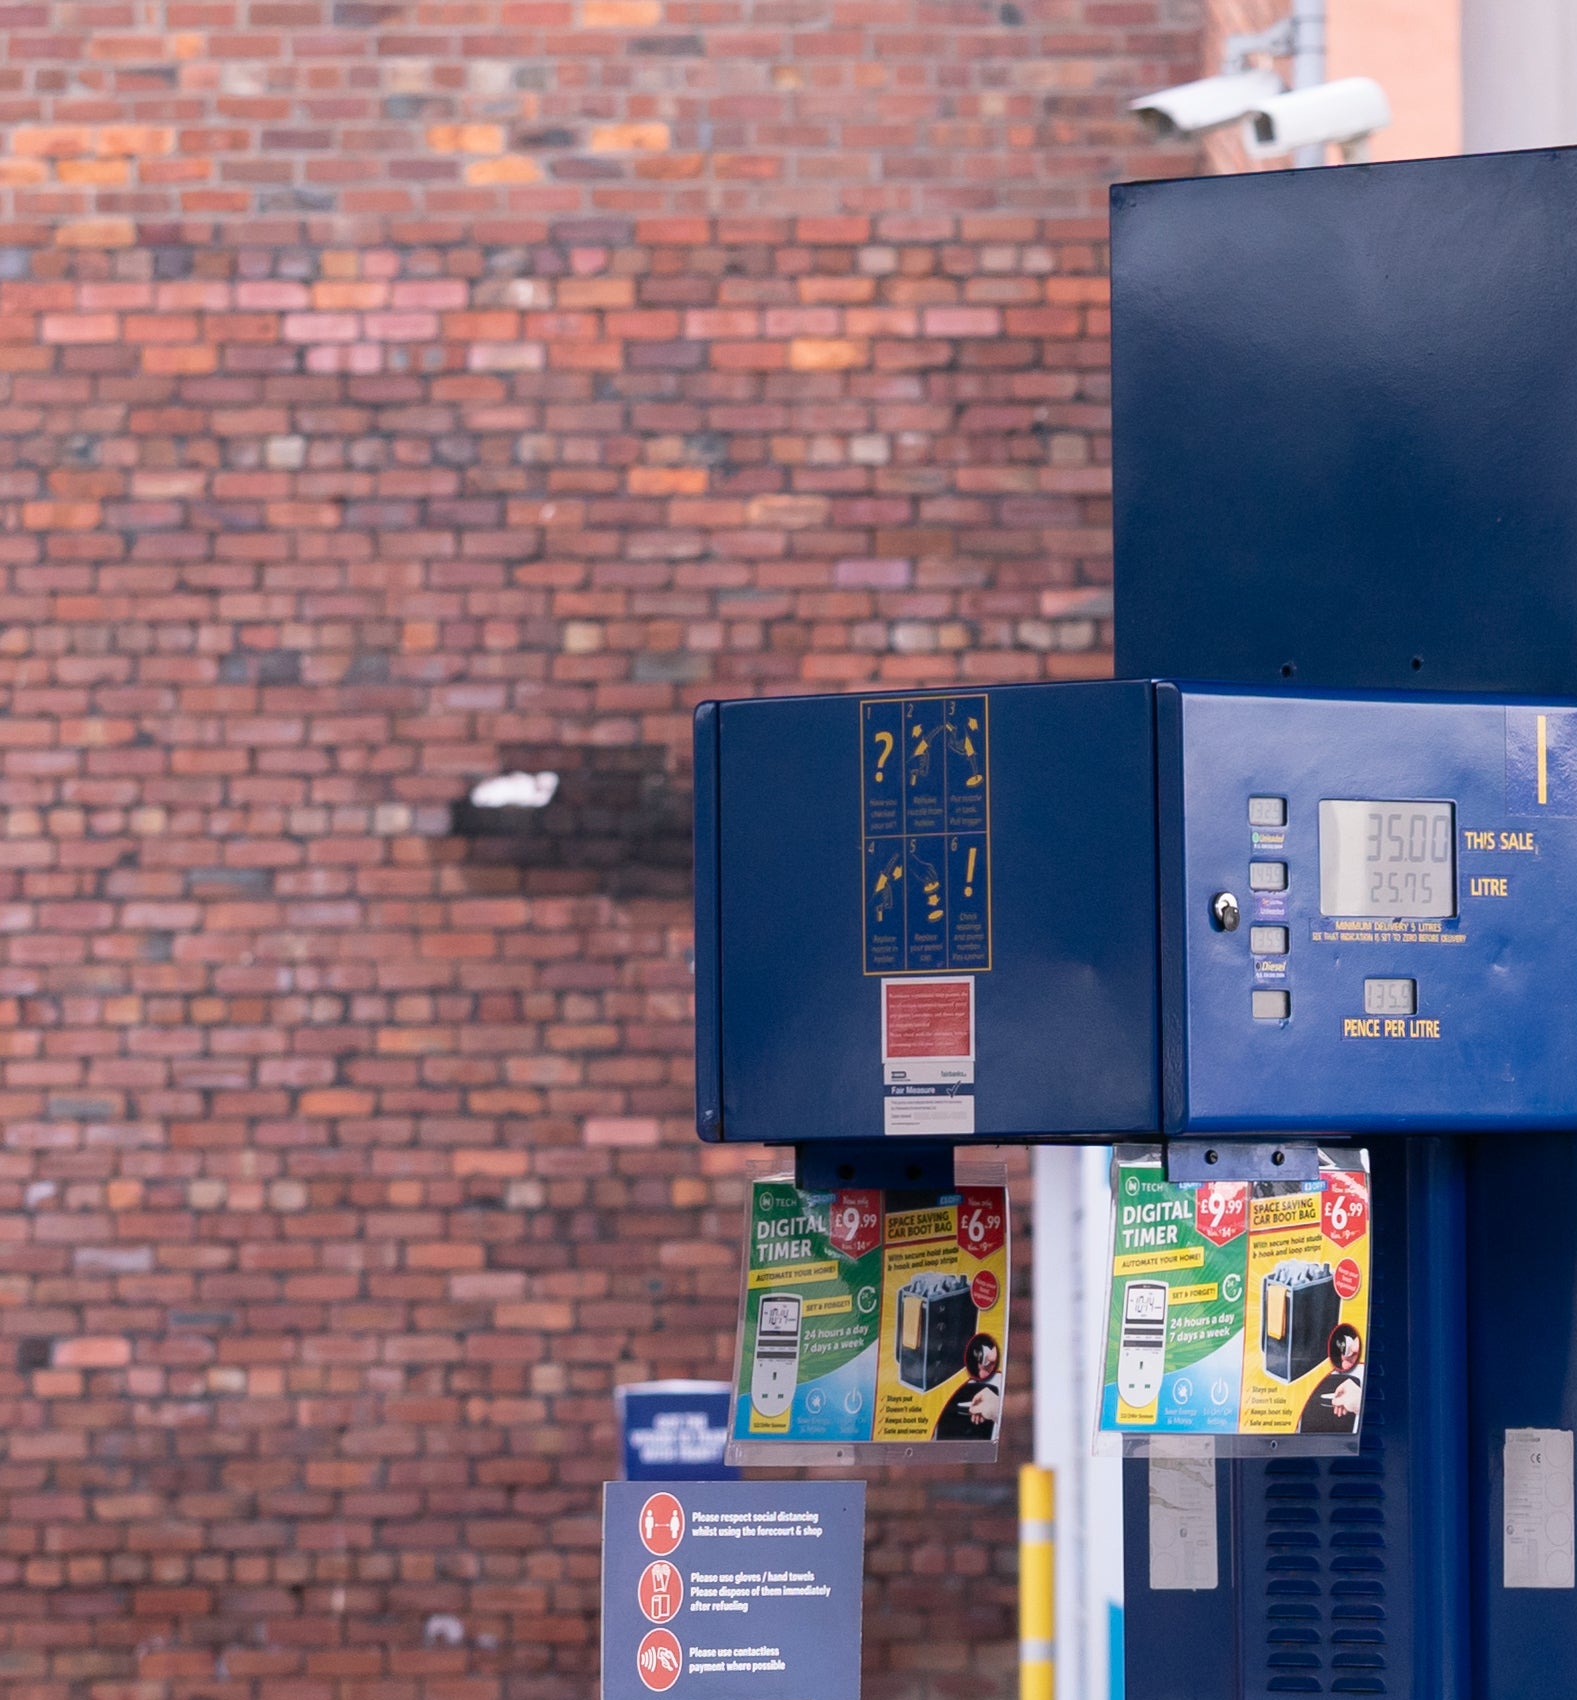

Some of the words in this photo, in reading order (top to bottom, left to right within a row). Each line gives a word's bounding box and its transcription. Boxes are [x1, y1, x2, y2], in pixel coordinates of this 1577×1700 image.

[948, 701, 955, 715] 3
[1367, 814, 1450, 863] 35.00
[1465, 831, 1495, 850] THIS
[1501, 832, 1534, 850] SALE
[1371, 872, 1432, 903] 25.75
[1471, 879, 1508, 896] LITRE
[1418, 922, 1442, 933] LITRES
[1262, 961, 1287, 971] Diesel
[1344, 1019, 1380, 1037] PENCE
[1384, 1019, 1405, 1037] PER
[1410, 1020, 1440, 1038] LITRE
[891, 1086, 904, 1094] Fair
[906, 1086, 935, 1094] Measure
[1141, 1183, 1163, 1192] TECH
[776, 1198, 797, 1207] TECH
[1200, 1193, 1242, 1227] £9.99
[1254, 1202, 1280, 1214] SPACE
[1282, 1198, 1313, 1210] SAVING
[889, 1216, 915, 1228] SPACE
[917, 1211, 949, 1223] SAVING
[1123, 1200, 1192, 1225] DIGITAL
[1254, 1214, 1270, 1225] CAR
[1273, 1212, 1297, 1223] BOOT
[1299, 1209, 1316, 1219] BAG
[1325, 1196, 1363, 1230] £6.99
[757, 1216, 826, 1239] DIGITAL
[835, 1207, 877, 1241] £9.99
[888, 1227, 905, 1239] CAR
[908, 1225, 932, 1236] BOOT
[935, 1221, 952, 1233] BAG
[961, 1208, 1000, 1242] £6.99
[1123, 1225, 1178, 1248] TIMER
[757, 1240, 812, 1262] TIMER
[1122, 1258, 1158, 1268] AUTOMATE
[1160, 1255, 1177, 1264] YOUR
[1179, 1253, 1200, 1262] HOME!
[756, 1270, 792, 1281] AUTOMATE
[794, 1268, 812, 1277] YOUR
[1170, 1318, 1182, 1329] 24
[1184, 1315, 1210, 1328] hours
[1218, 1313, 1234, 1325] day
[804, 1330, 816, 1340] 24
[818, 1327, 844, 1339] hours
[853, 1324, 869, 1336] day
[1170, 1333, 1175, 1343] 7
[1177, 1331, 1197, 1342] days
[1206, 1327, 1230, 1338] week
[804, 1343, 809, 1353] 7
[811, 1341, 831, 1355] days
[841, 1338, 864, 1349] week
[692, 1511, 719, 1523] Please
[721, 1512, 752, 1525] respect
[753, 1512, 776, 1522] social
[778, 1511, 819, 1524] distancing
[692, 1526, 717, 1537] whilst
[719, 1527, 741, 1539] using
[743, 1526, 756, 1536] the
[757, 1526, 795, 1536] forecourt
[795, 1526, 802, 1535] &
[803, 1526, 823, 1538] shop
[690, 1572, 718, 1583] Please
[719, 1574, 734, 1583] use
[735, 1572, 761, 1584] gloves
[767, 1572, 788, 1582] hand
[789, 1571, 815, 1582] towels
[690, 1586, 717, 1597] Please
[719, 1586, 749, 1599] dispose
[751, 1586, 760, 1596] of
[761, 1585, 781, 1596] them
[782, 1585, 831, 1598] immediately
[690, 1601, 710, 1612] after
[712, 1601, 748, 1613] refueling
[689, 1647, 716, 1658] Please
[717, 1649, 732, 1658] use
[733, 1646, 780, 1657] contactless
[689, 1662, 725, 1674] payment
[727, 1660, 751, 1672] where
[752, 1659, 785, 1672] possible
